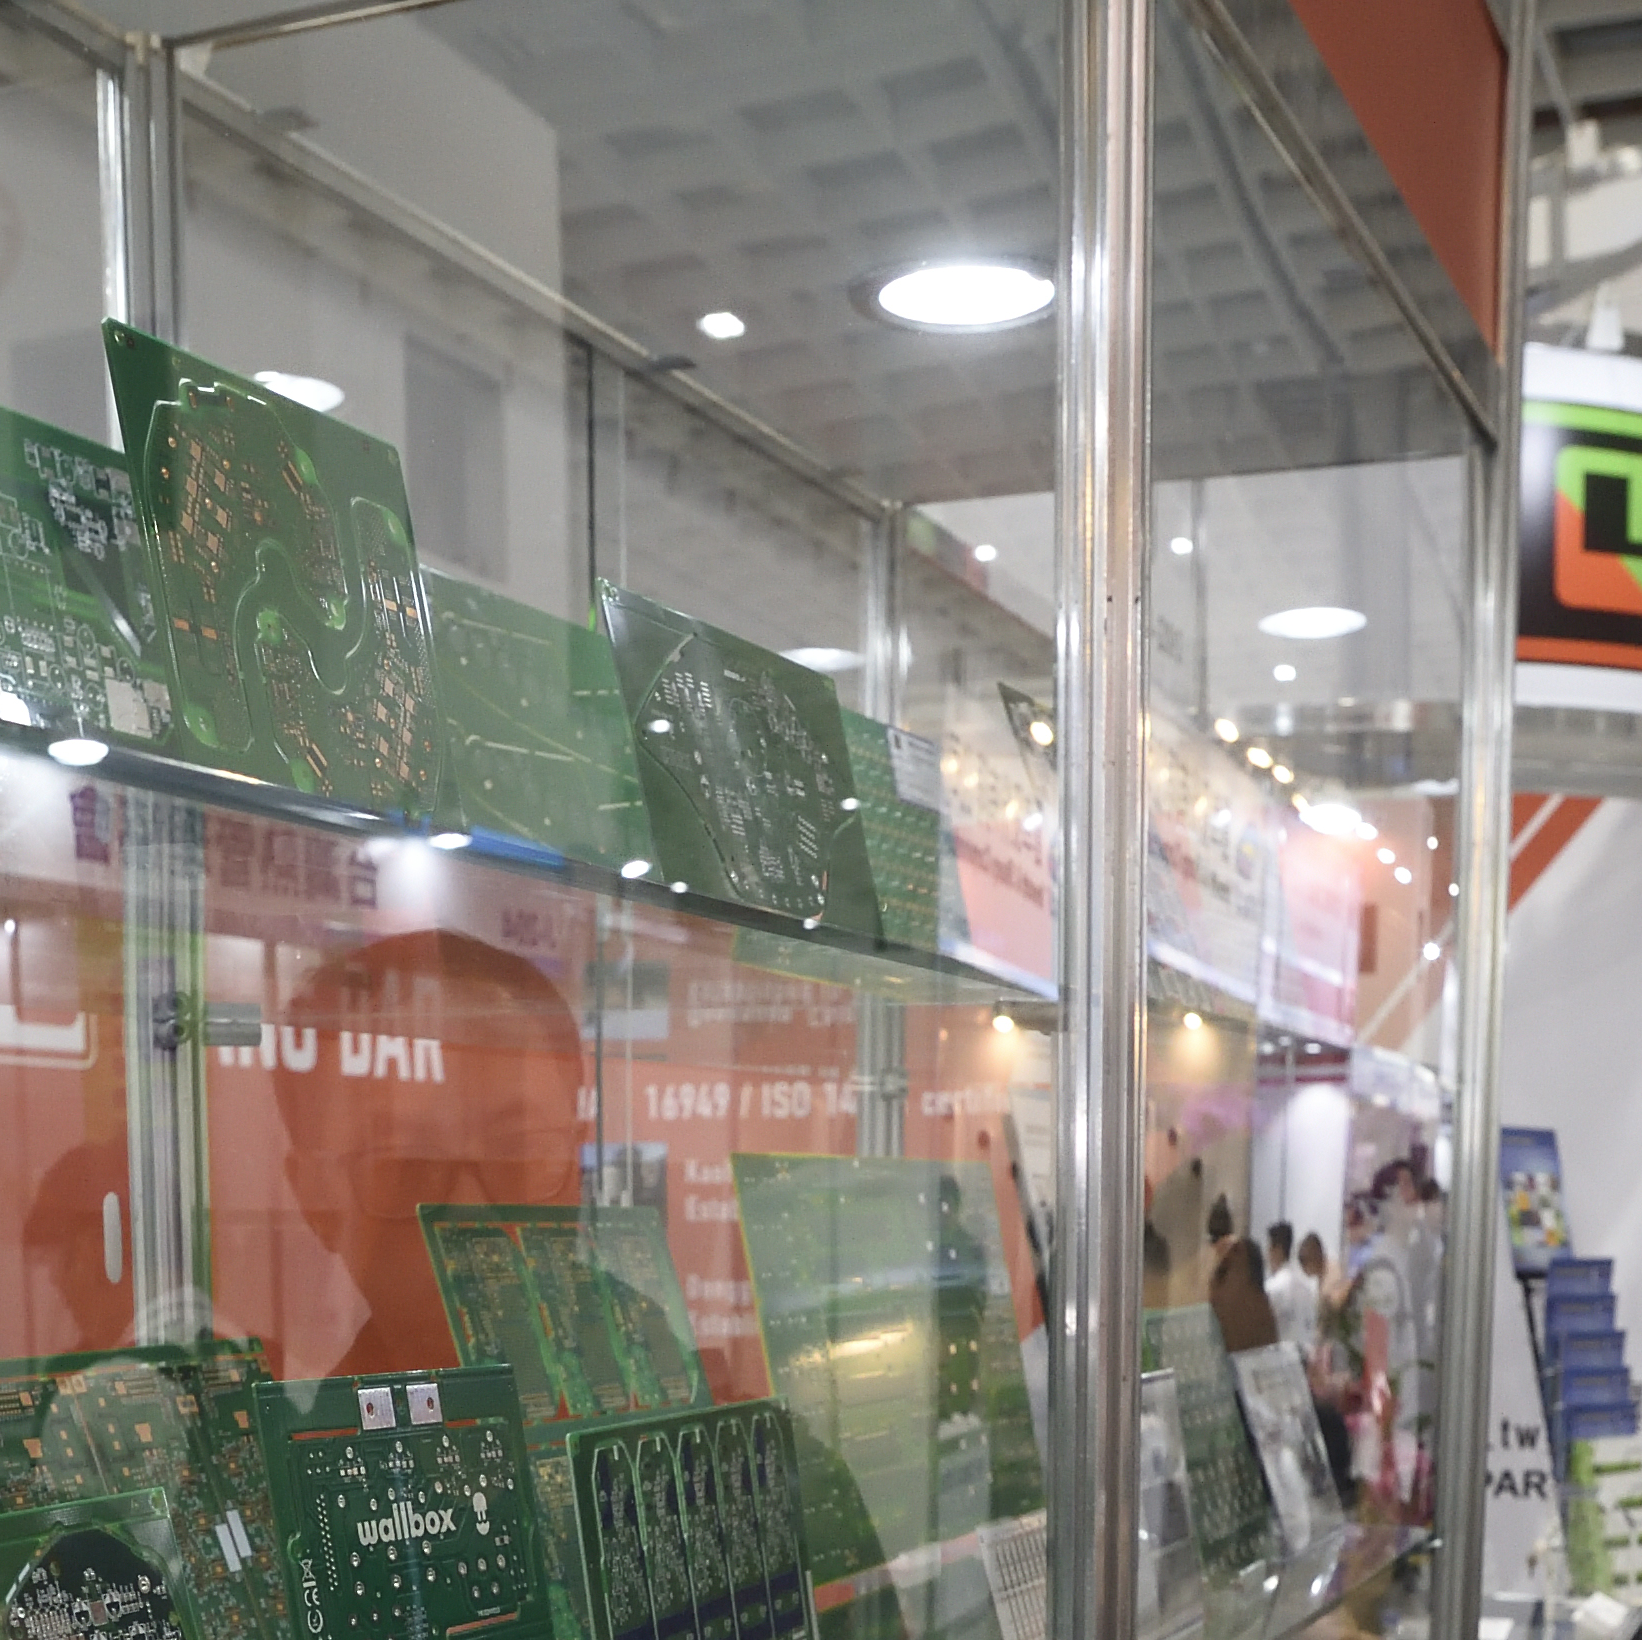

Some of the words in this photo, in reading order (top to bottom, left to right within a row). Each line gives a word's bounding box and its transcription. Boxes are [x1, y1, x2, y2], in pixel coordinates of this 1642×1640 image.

[645, 1084, 730, 1121] 16949
[761, 1082, 811, 1117] ISO
[357, 1501, 457, 1547] wallbox
